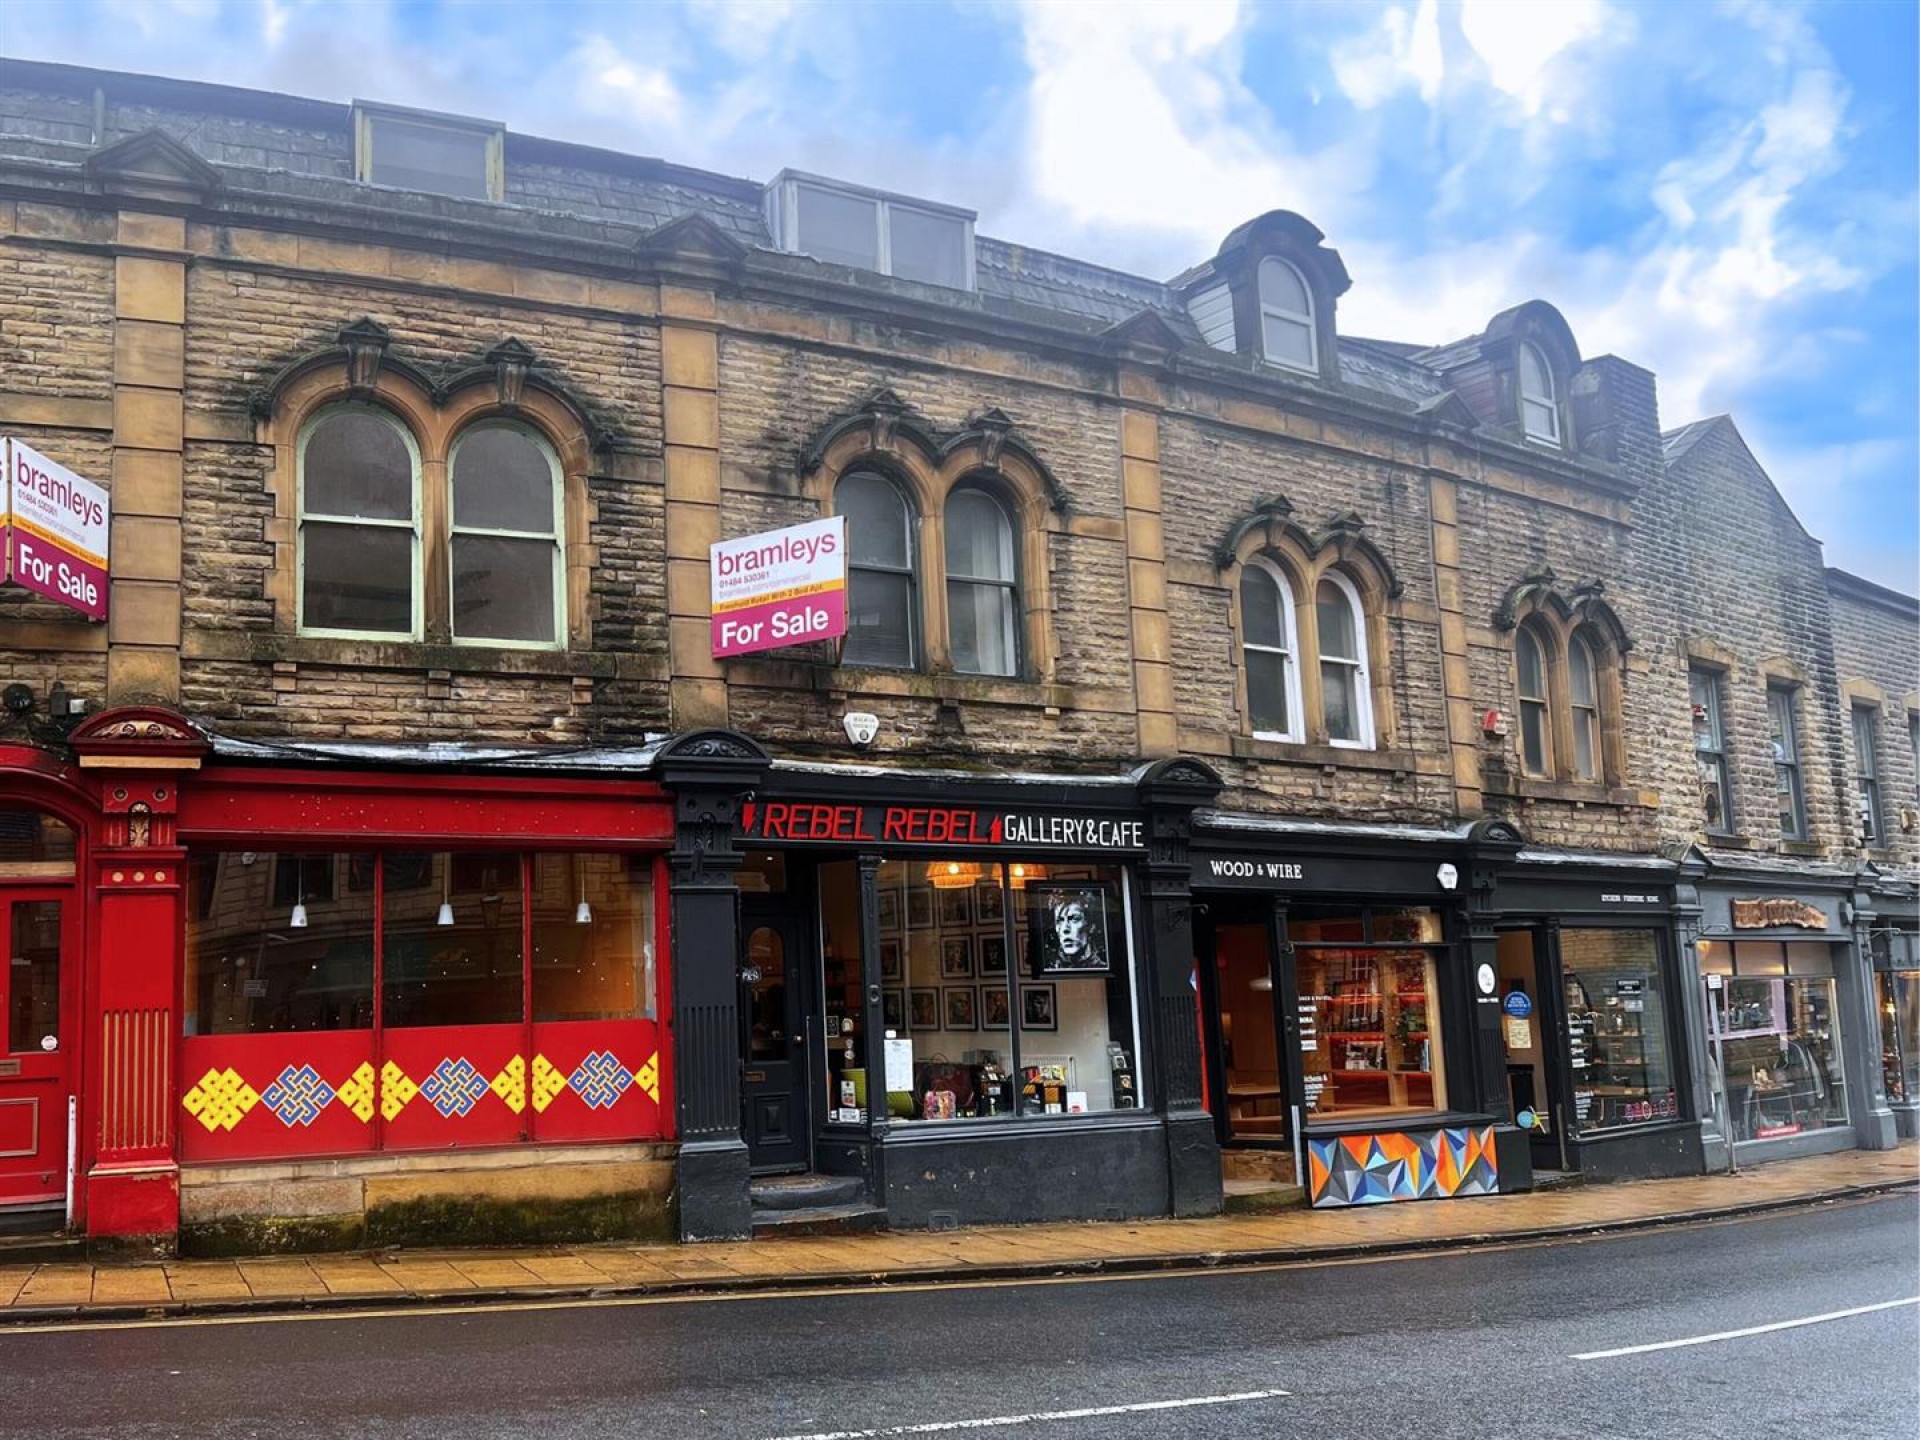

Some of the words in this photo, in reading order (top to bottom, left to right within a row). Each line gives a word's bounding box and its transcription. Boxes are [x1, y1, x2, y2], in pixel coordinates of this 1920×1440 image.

[17, 451, 103, 526] bramleys
[20, 543, 53, 585] For
[58, 563, 97, 607] Sale
[718, 533, 836, 576] bramleys
[721, 620, 764, 648] For
[771, 606, 829, 638] Sale
[763, 803, 875, 841] REBEL
[884, 807, 988, 843] REBEL
[1210, 860, 1253, 877] WOOD
[1257, 863, 1264, 876] &
[1266, 863, 1303, 879] WIRE
